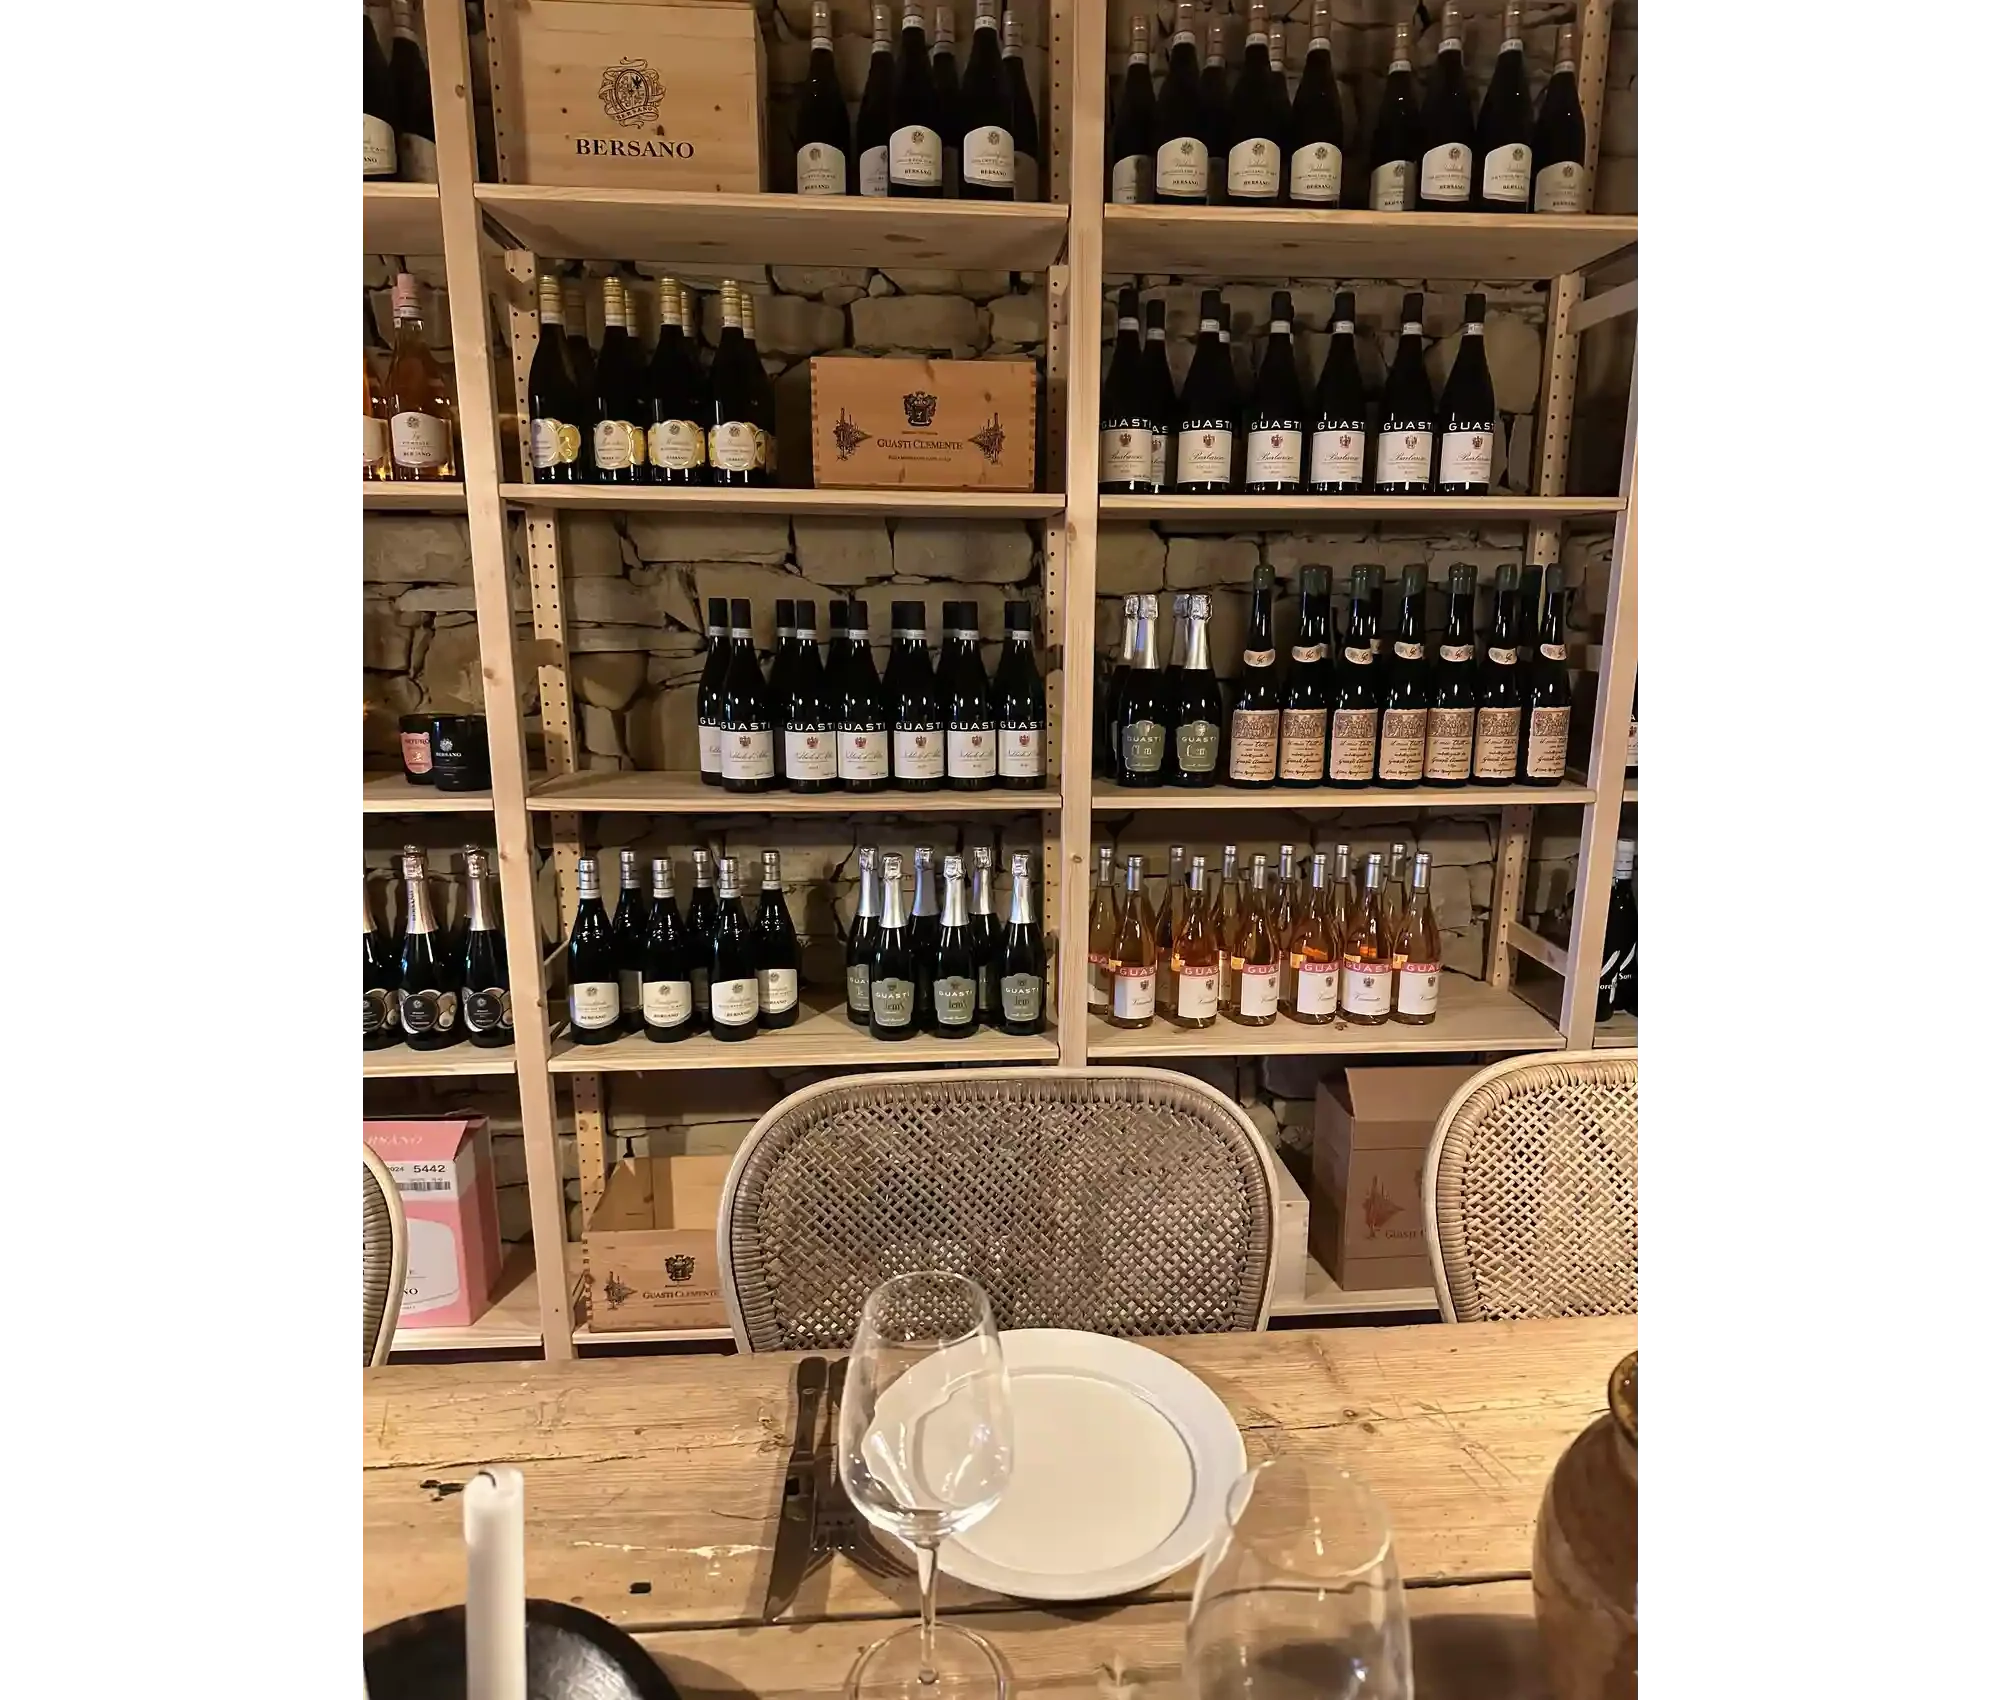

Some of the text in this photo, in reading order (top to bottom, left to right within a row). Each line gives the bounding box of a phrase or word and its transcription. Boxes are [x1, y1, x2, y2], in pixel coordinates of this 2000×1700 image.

[616, 106, 653, 119] BERSANO
[576, 139, 694, 158] BERSANO
[1101, 418, 1152, 429] GUASTI
[1182, 419, 1232, 430] GUASTI
[877, 438, 964, 450] GUASTI CLEMENTE
[720, 721, 771, 731] GUASTI
[875, 989, 910, 999] GUASTI
[413, 1164, 446, 1173] 5442
[642, 1290, 674, 1299] GUASTI
